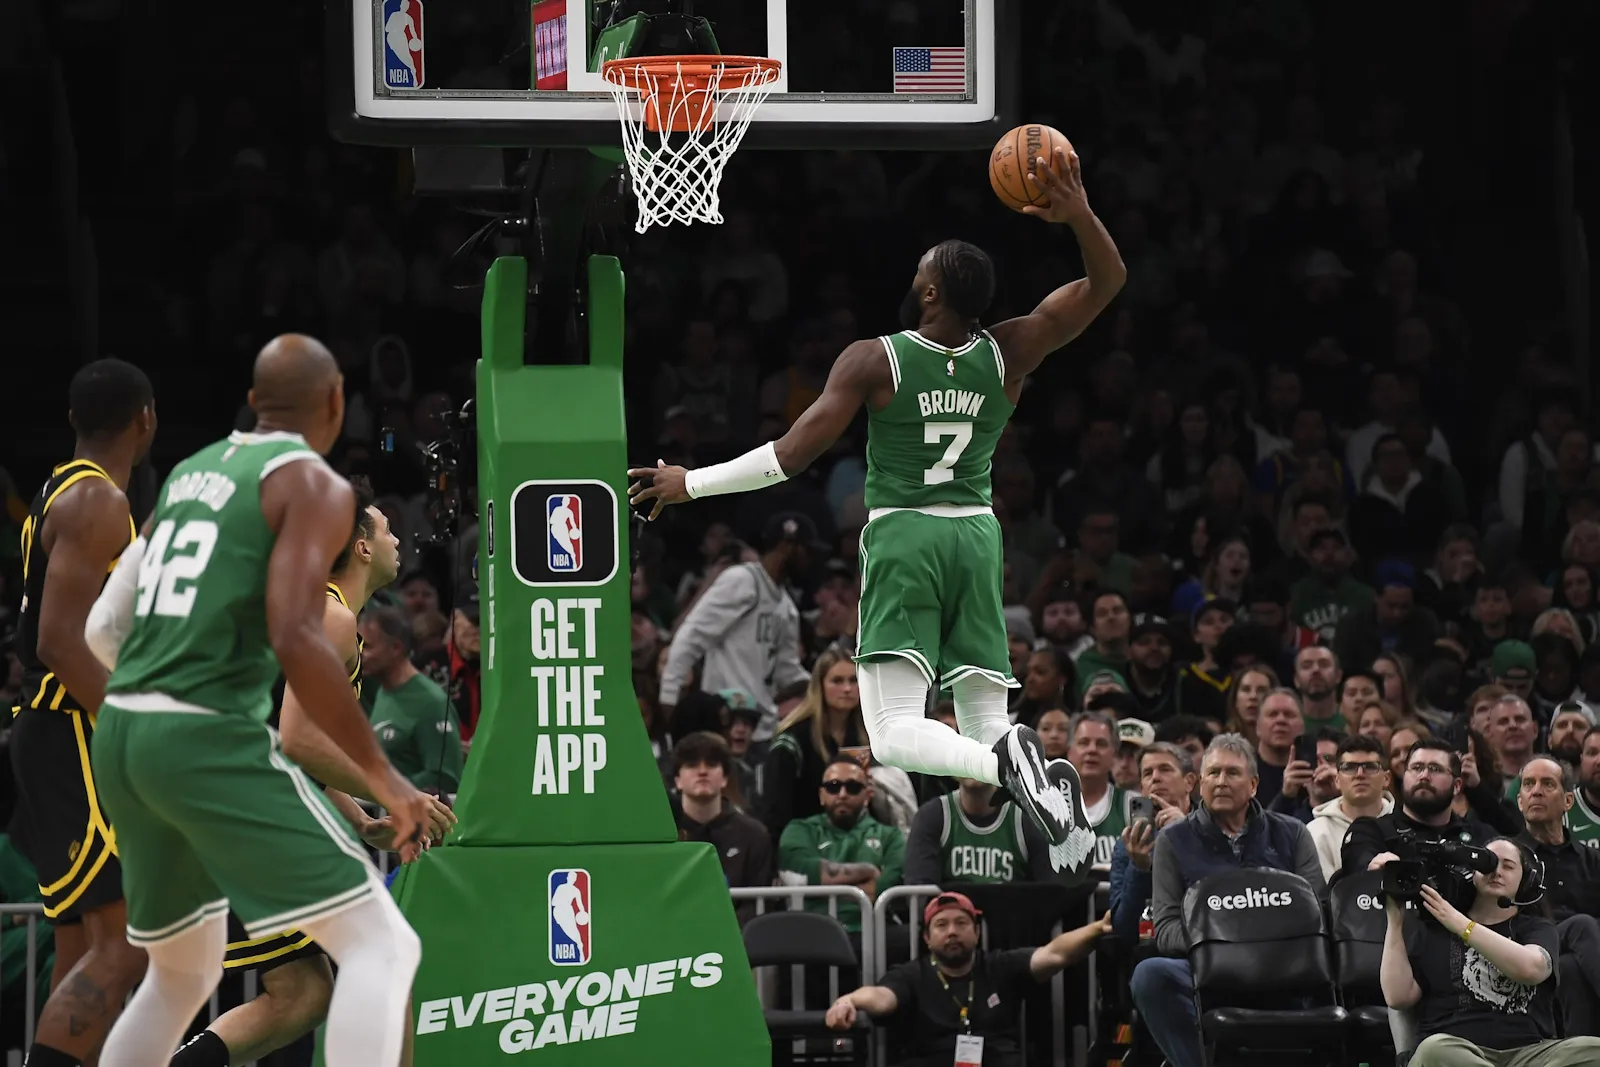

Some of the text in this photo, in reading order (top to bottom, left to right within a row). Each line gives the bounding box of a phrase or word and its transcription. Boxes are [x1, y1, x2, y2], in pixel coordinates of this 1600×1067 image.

[389, 68, 409, 84] NBA
[917, 388, 986, 418] BROWN
[923, 421, 973, 485] 7
[135, 519, 219, 618] 42
[553, 553, 570, 567] NBA
[530, 597, 602, 660] GET
[530, 665, 606, 727] THE
[531, 733, 607, 795] APP
[951, 845, 1014, 882] CELTICS
[1207, 887, 1292, 911] @celtics
[555, 943, 576, 960] NBA
[416, 952, 724, 1035] EVERYONE'S
[498, 999, 640, 1055] GAME
